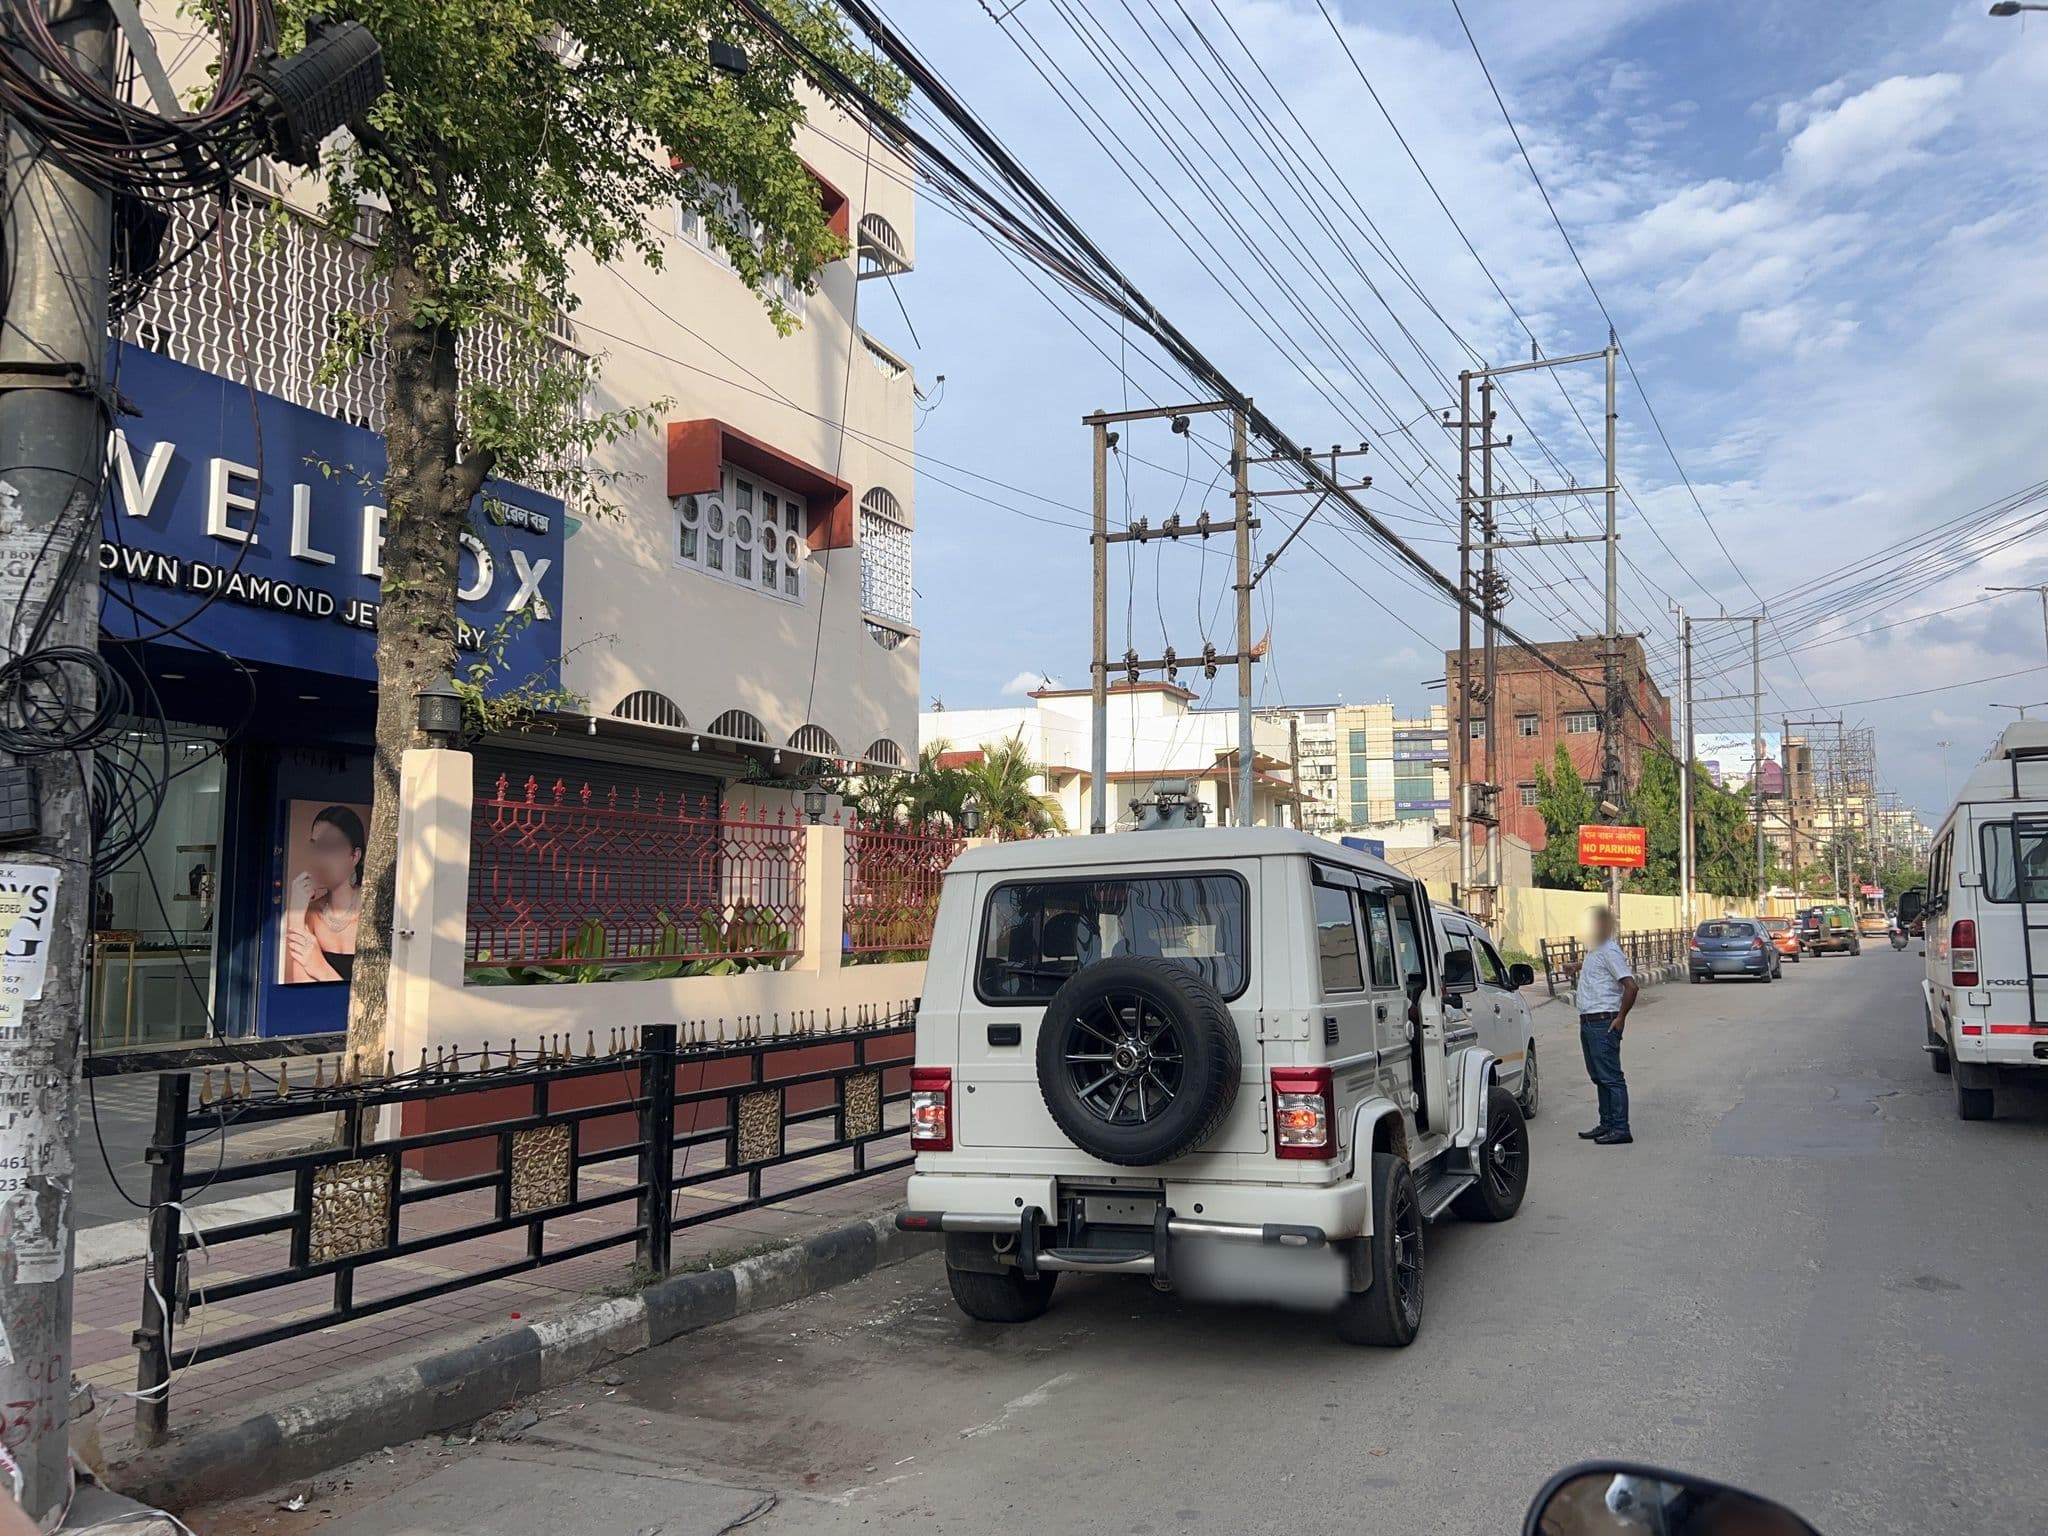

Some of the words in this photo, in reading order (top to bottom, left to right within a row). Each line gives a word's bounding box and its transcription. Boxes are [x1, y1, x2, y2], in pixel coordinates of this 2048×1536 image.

[193, 564, 335, 616] DIAMOND
[1582, 843, 1597, 853] NO
[1600, 844, 1642, 855] PARKING
